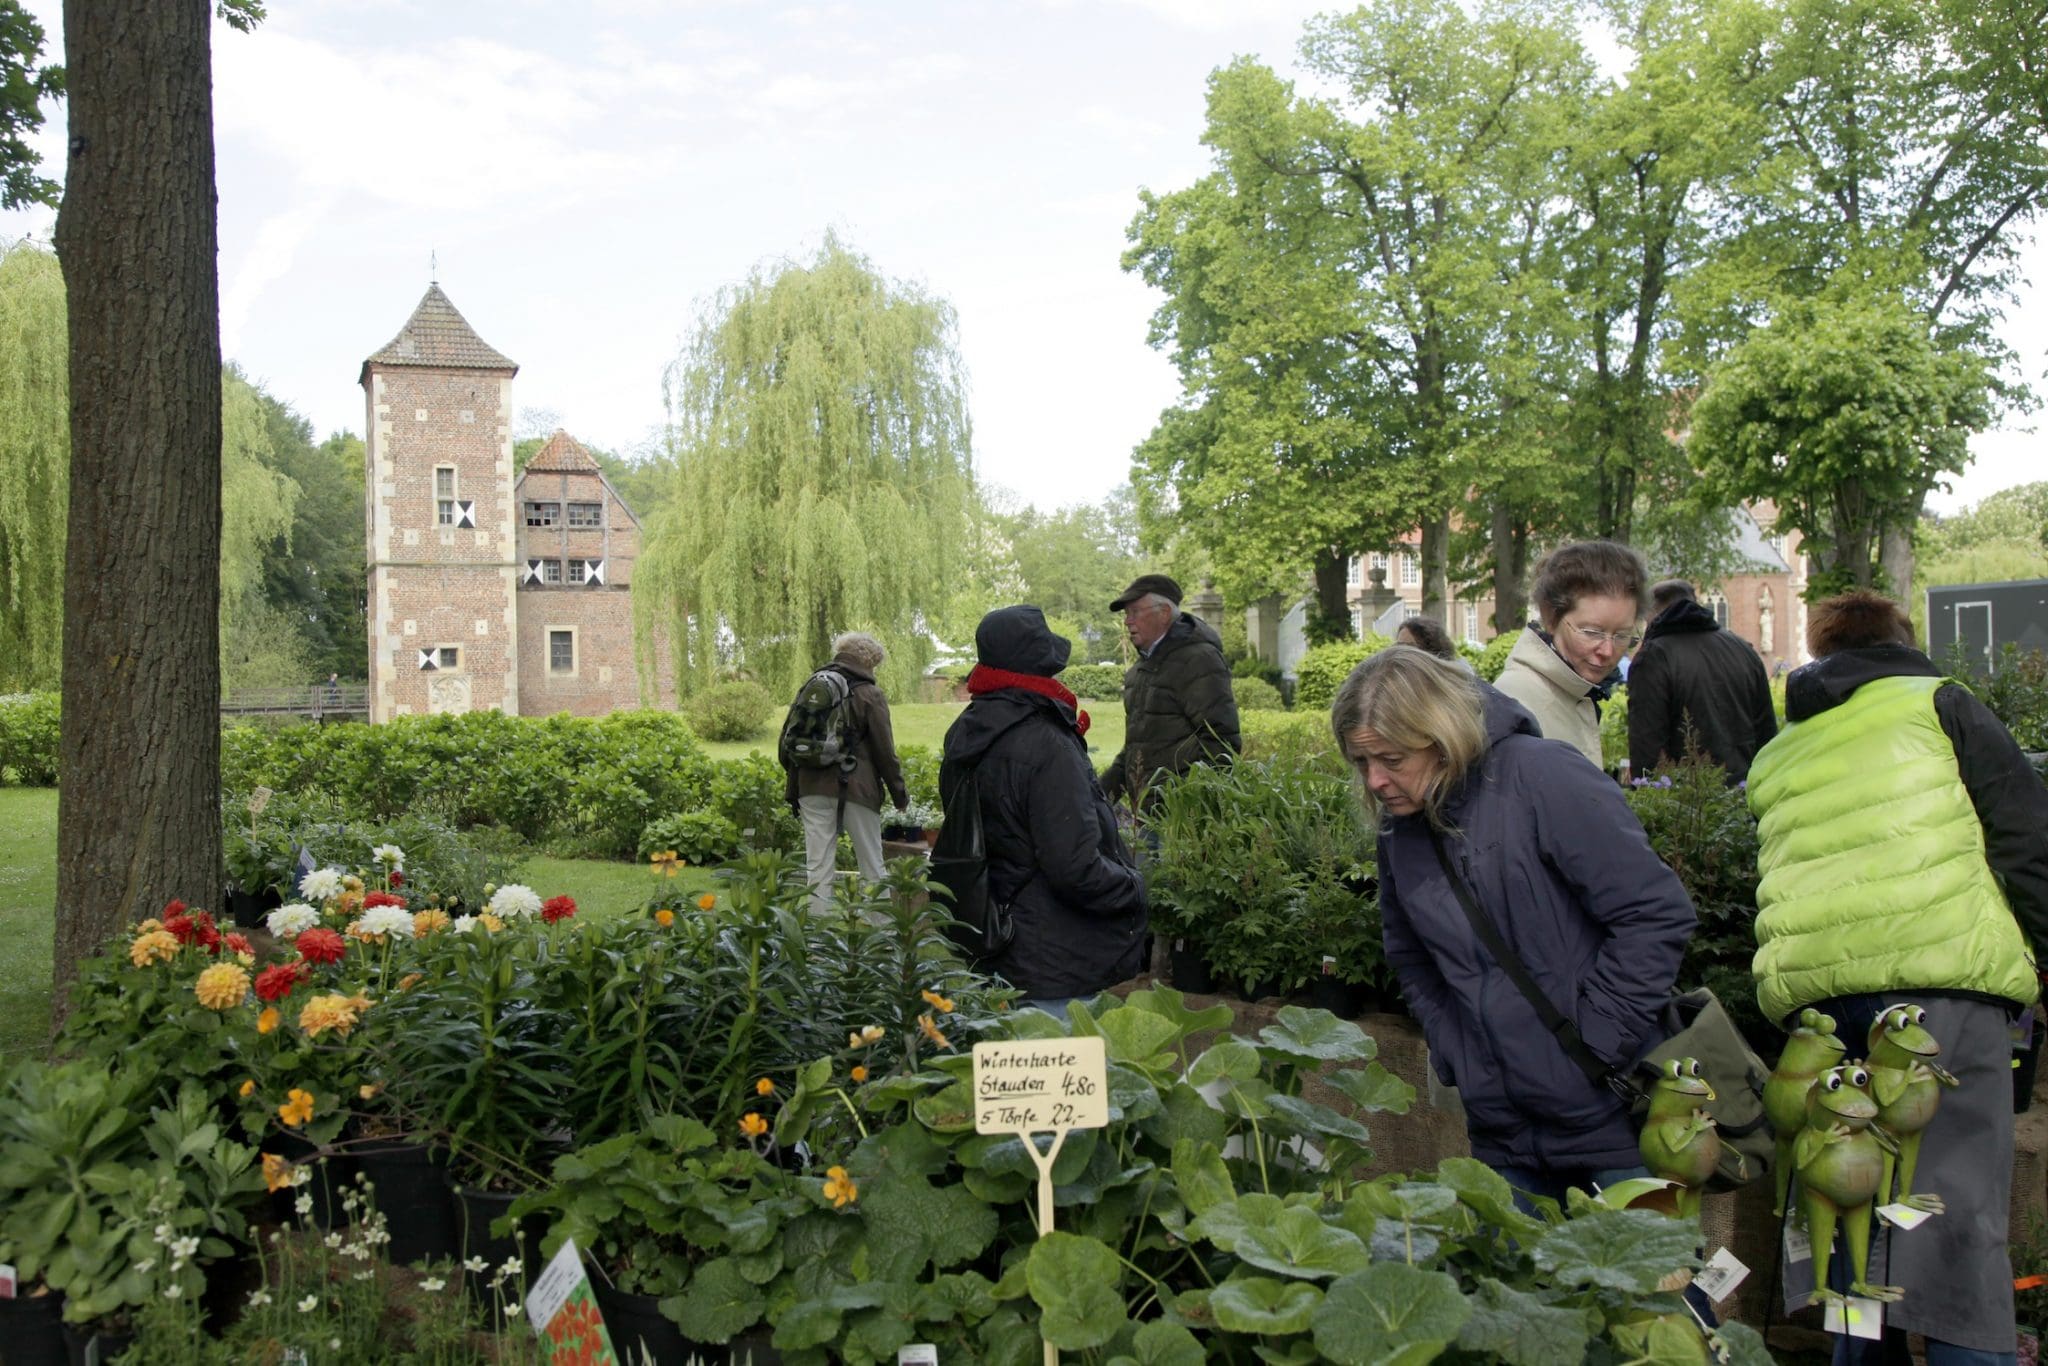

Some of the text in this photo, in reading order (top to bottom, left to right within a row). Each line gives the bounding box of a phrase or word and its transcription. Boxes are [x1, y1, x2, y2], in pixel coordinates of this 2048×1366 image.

[980, 1051, 1078, 1069] Winterharte
[979, 1071, 1096, 1097] Stauden 4.80
[980, 1110, 994, 1125] 5
[998, 1105, 1039, 1129] Töpfe
